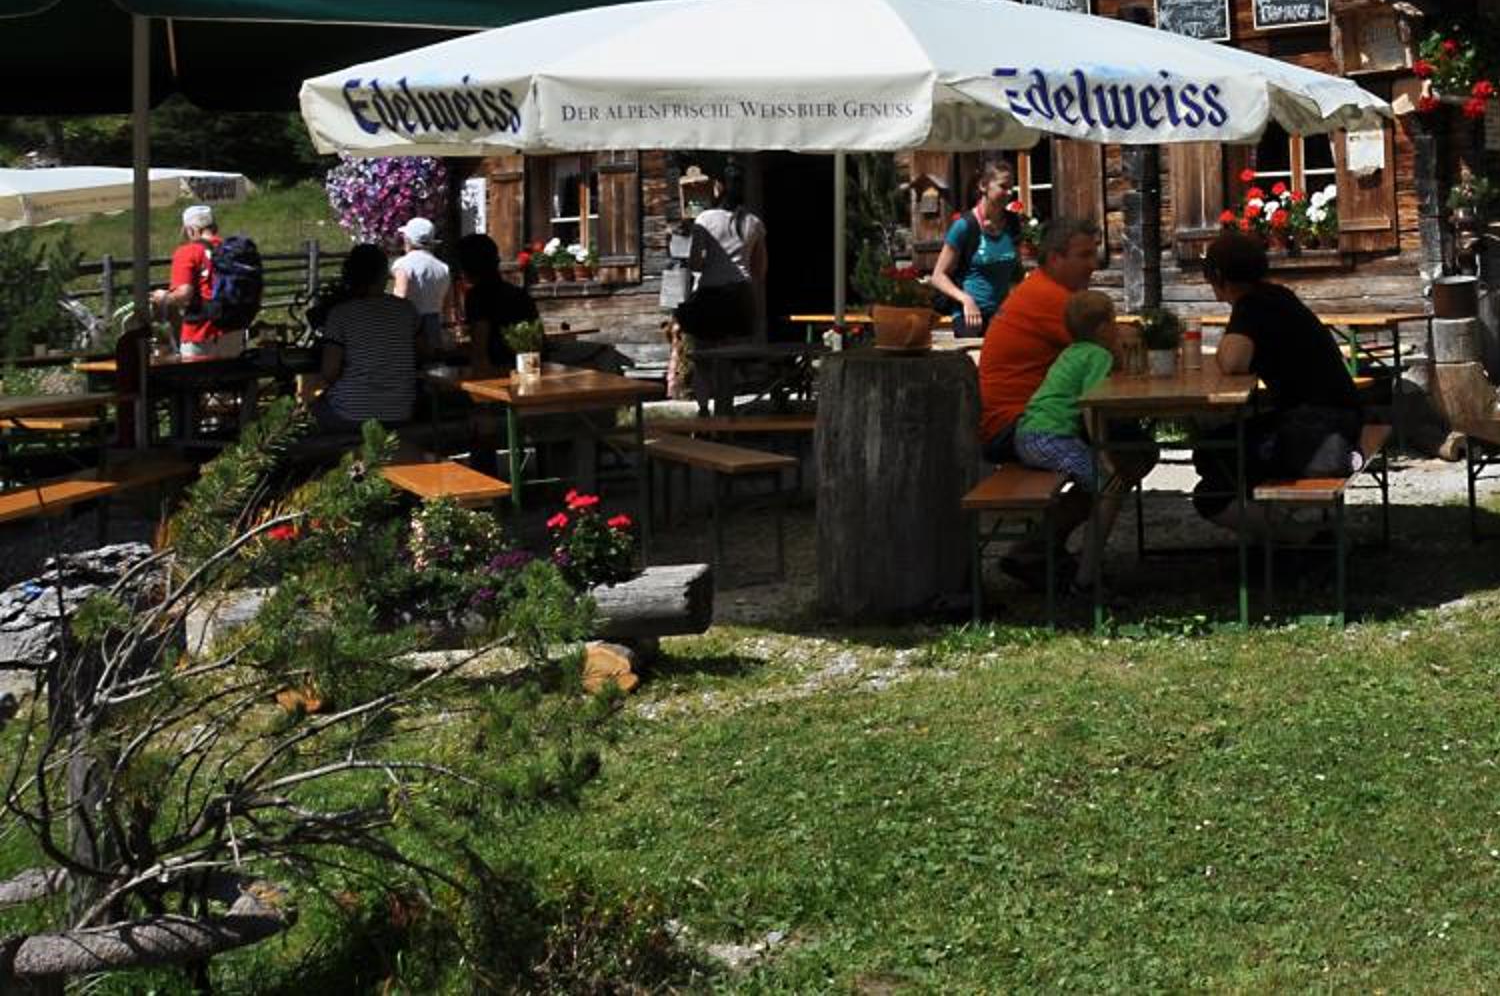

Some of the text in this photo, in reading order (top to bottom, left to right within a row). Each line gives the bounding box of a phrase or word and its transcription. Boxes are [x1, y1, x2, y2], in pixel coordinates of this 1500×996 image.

[342, 74, 521, 134] Edelweiss
[561, 105, 599, 122] DER
[740, 100, 838, 119] WEISSBIER
[843, 100, 914, 118] GENUSS
[992, 68, 1227, 130] Edelweiss
